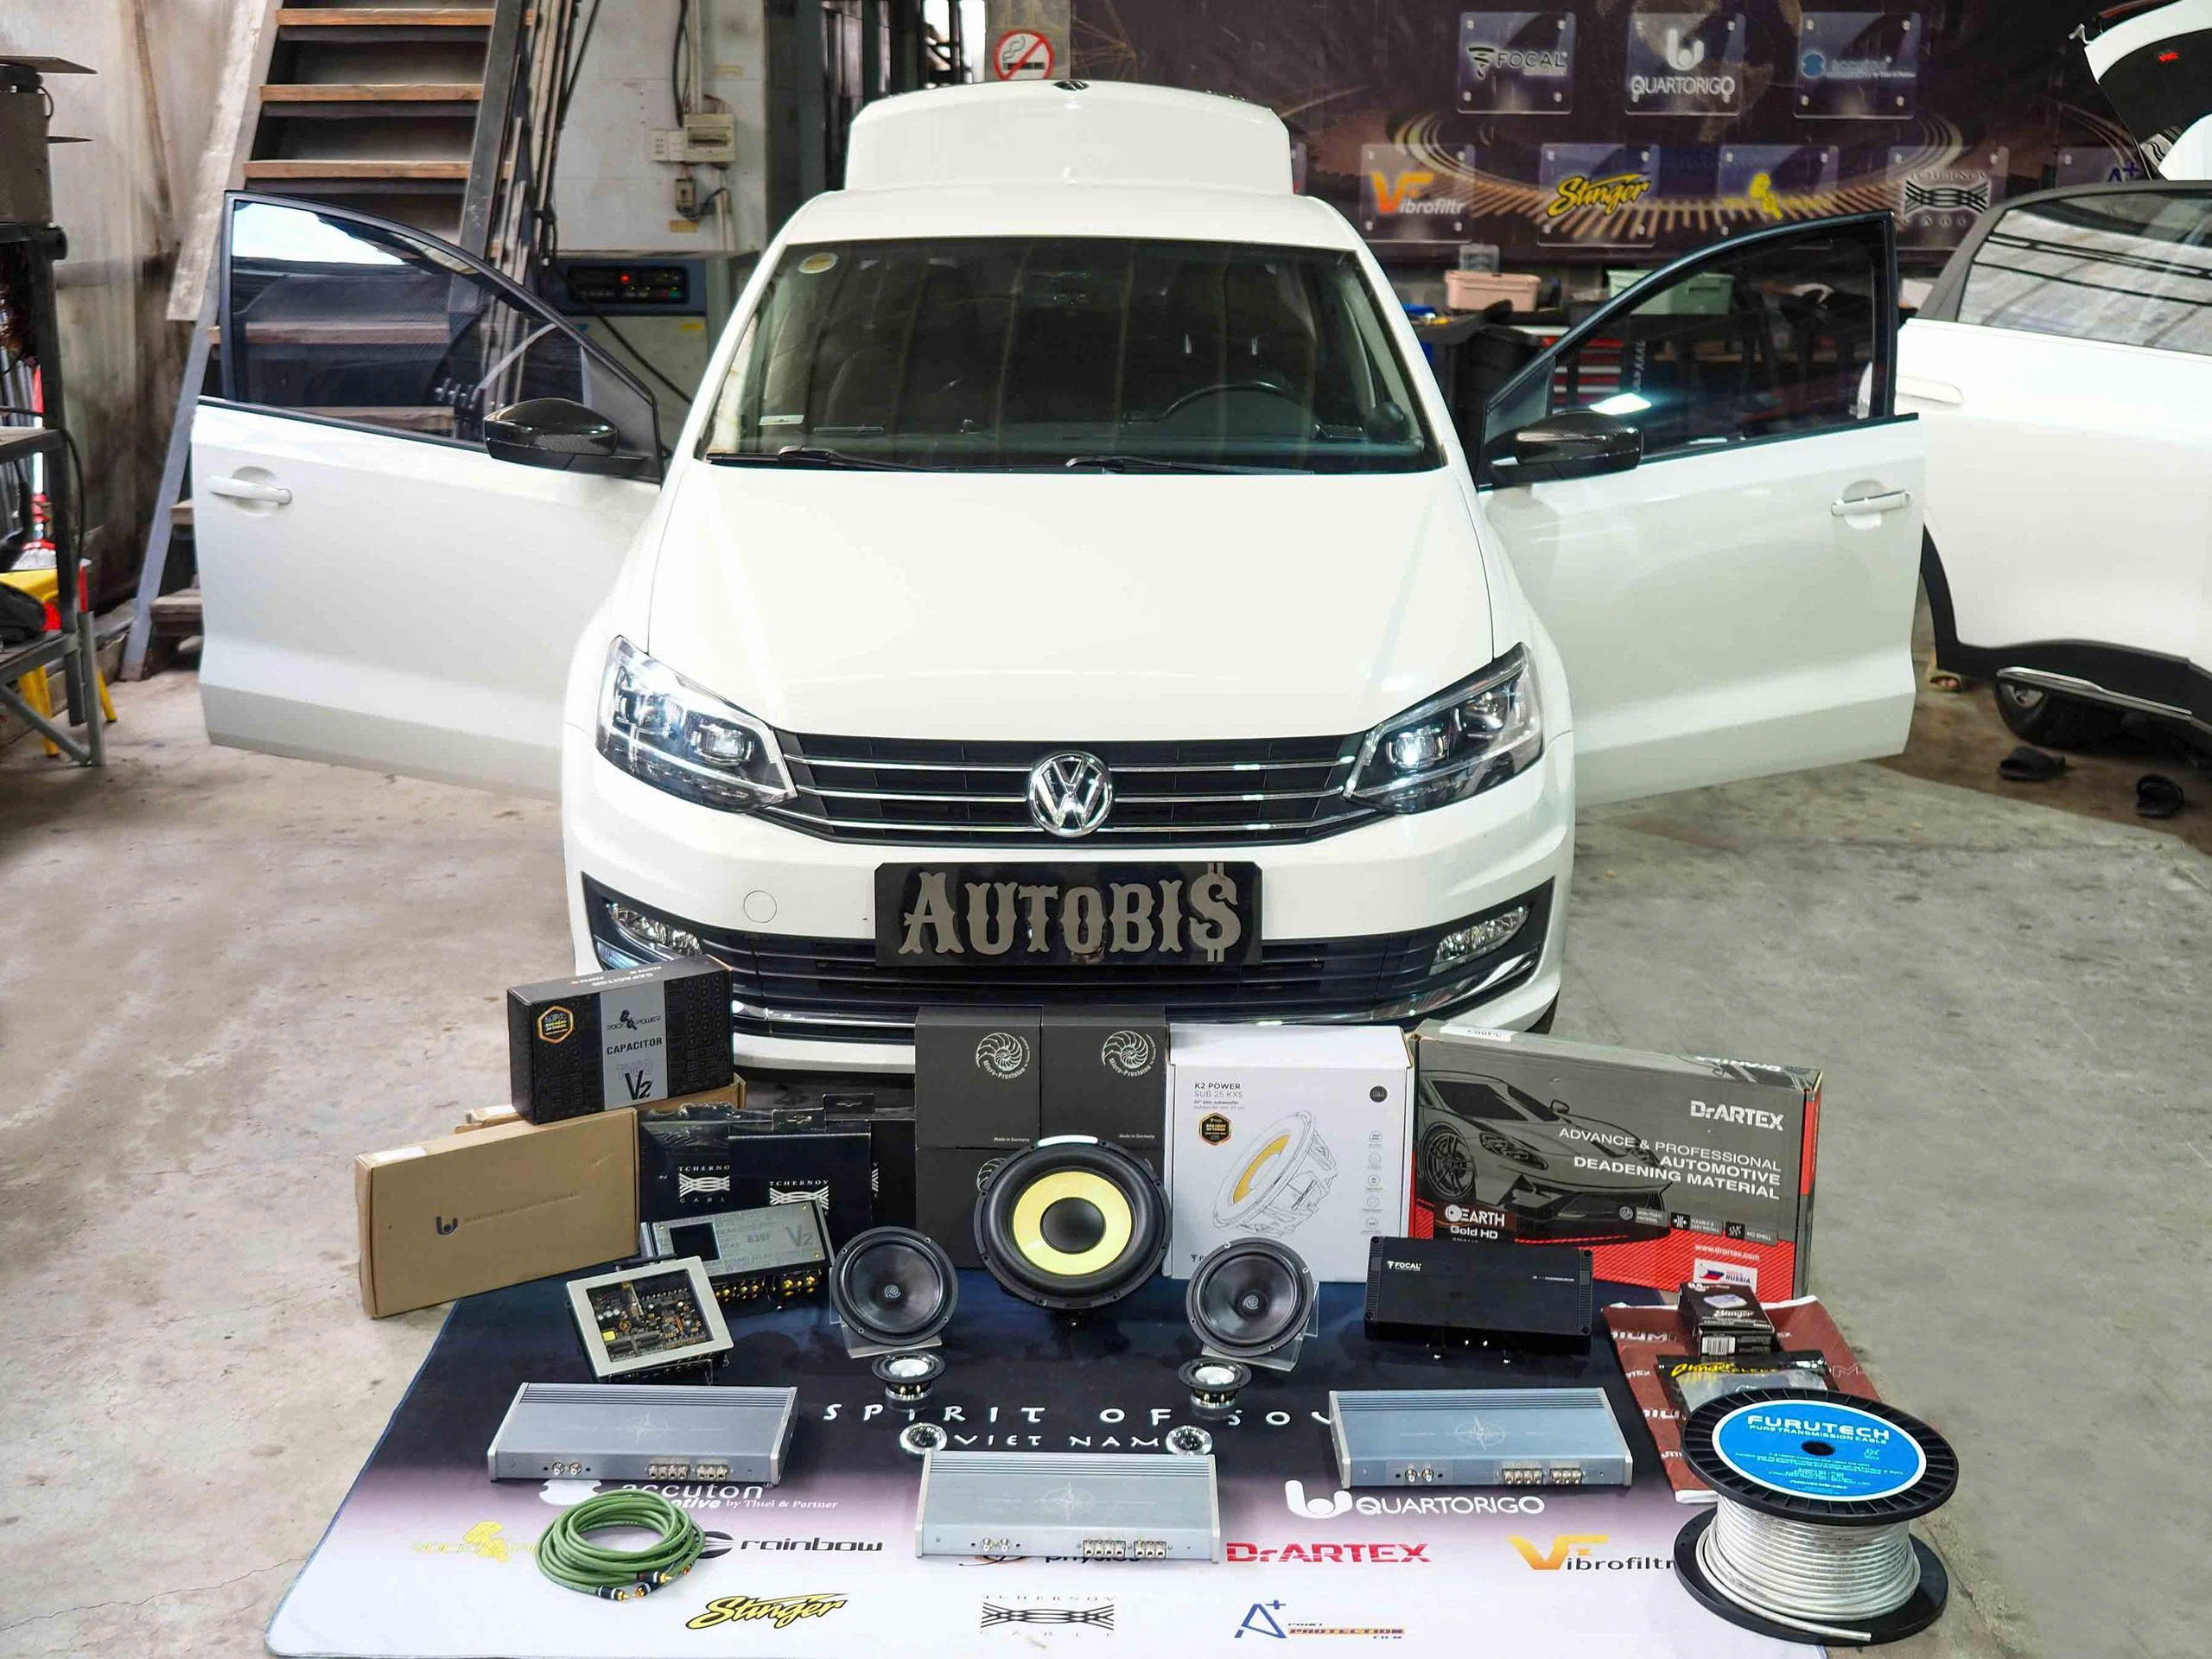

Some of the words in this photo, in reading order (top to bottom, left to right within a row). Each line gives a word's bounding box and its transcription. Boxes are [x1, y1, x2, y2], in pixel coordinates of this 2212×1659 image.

[1496, 51, 1567, 68] FOCAL
[1630, 76, 1736, 96] QUARTORIGO
[1547, 173, 1651, 216] Stinger
[607, 1037, 663, 1055] CAPACITOR
[624, 1070, 654, 1100] V2
[1690, 1100, 1784, 1131] DrARTEX
[1559, 1128, 1635, 1148] ADVANCE
[1639, 1139, 1649, 1151] &
[1655, 1141, 1782, 1173] PROFESSIONAL
[1573, 1155, 1681, 1183] DEADENING
[1687, 1172, 1781, 1200] MATERIAL
[1659, 1154, 1781, 1186] AUTOMOTIVE
[1450, 1225, 1478, 1236] Gold
[1480, 1230, 1498, 1240] HD
[1726, 1273, 1751, 1285] RUSSIA
[823, 1403, 1046, 1423] SPIRIT
[1099, 1408, 1173, 1426] OF
[1747, 1414, 1890, 1440] FURUTECH
[1749, 1424, 1777, 1433] PURE
[1777, 1427, 1854, 1441] TRANSMISSION
[1854, 1434, 1887, 1445] CABLE
[954, 1433, 1043, 1446] VIET
[1070, 1435, 1160, 1447] NAM
[726, 1499, 741, 1510] by
[744, 1498, 775, 1508] Thiel
[792, 1500, 838, 1509] Partner
[1356, 1496, 1545, 1516] QUARTORIGO
[740, 1535, 883, 1553] rainbow
[1226, 1542, 1432, 1563] DrARTEX
[685, 1592, 849, 1630] Stinger
